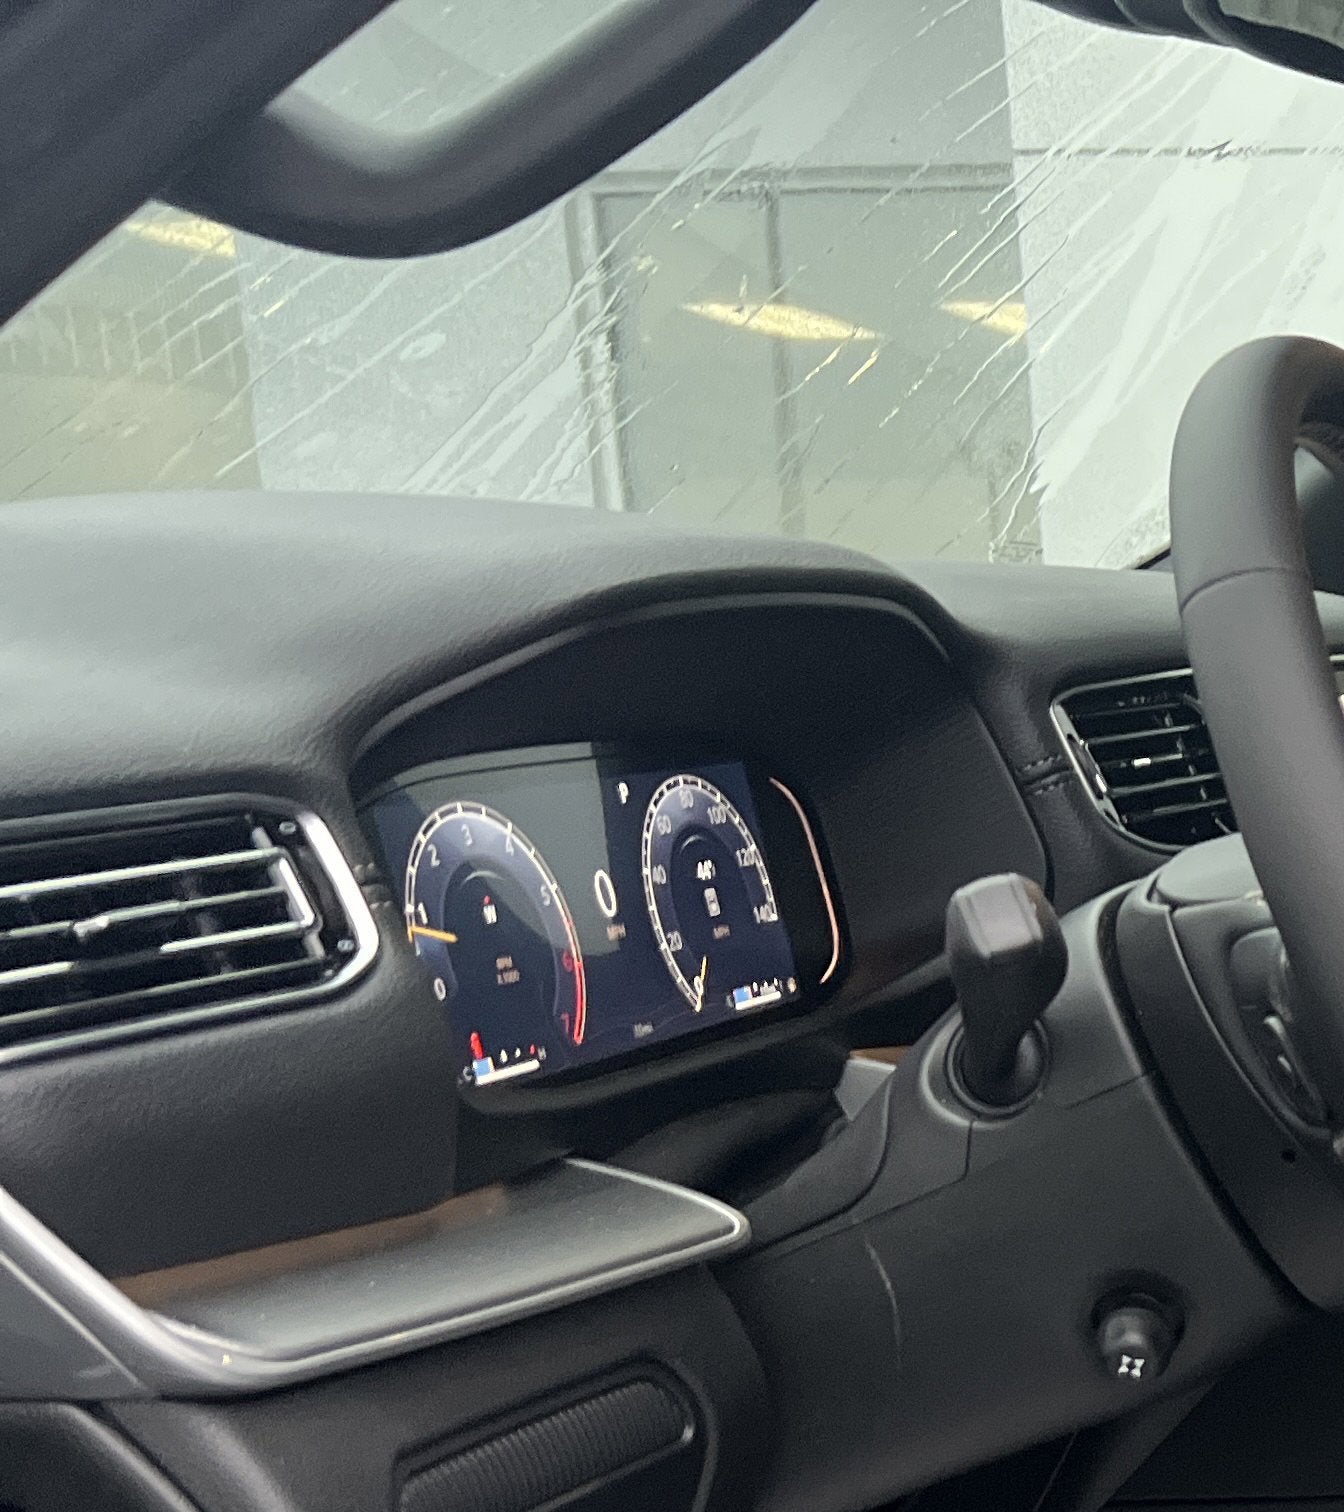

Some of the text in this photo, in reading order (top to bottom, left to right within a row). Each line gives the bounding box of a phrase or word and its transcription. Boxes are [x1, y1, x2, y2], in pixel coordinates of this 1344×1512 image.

[617, 782, 629, 804] P
[679, 788, 694, 809] 80
[707, 806, 728, 825] 100
[461, 823, 473, 846] 3
[427, 844, 441, 868] 2
[736, 847, 756, 867] 120
[652, 864, 667, 885] 40
[540, 885, 551, 907] 5
[594, 868, 618, 918] 0
[417, 902, 429, 925] 1
[666, 931, 683, 951] 20
[433, 977, 447, 1002] 0
[560, 1011, 571, 1035] 7
